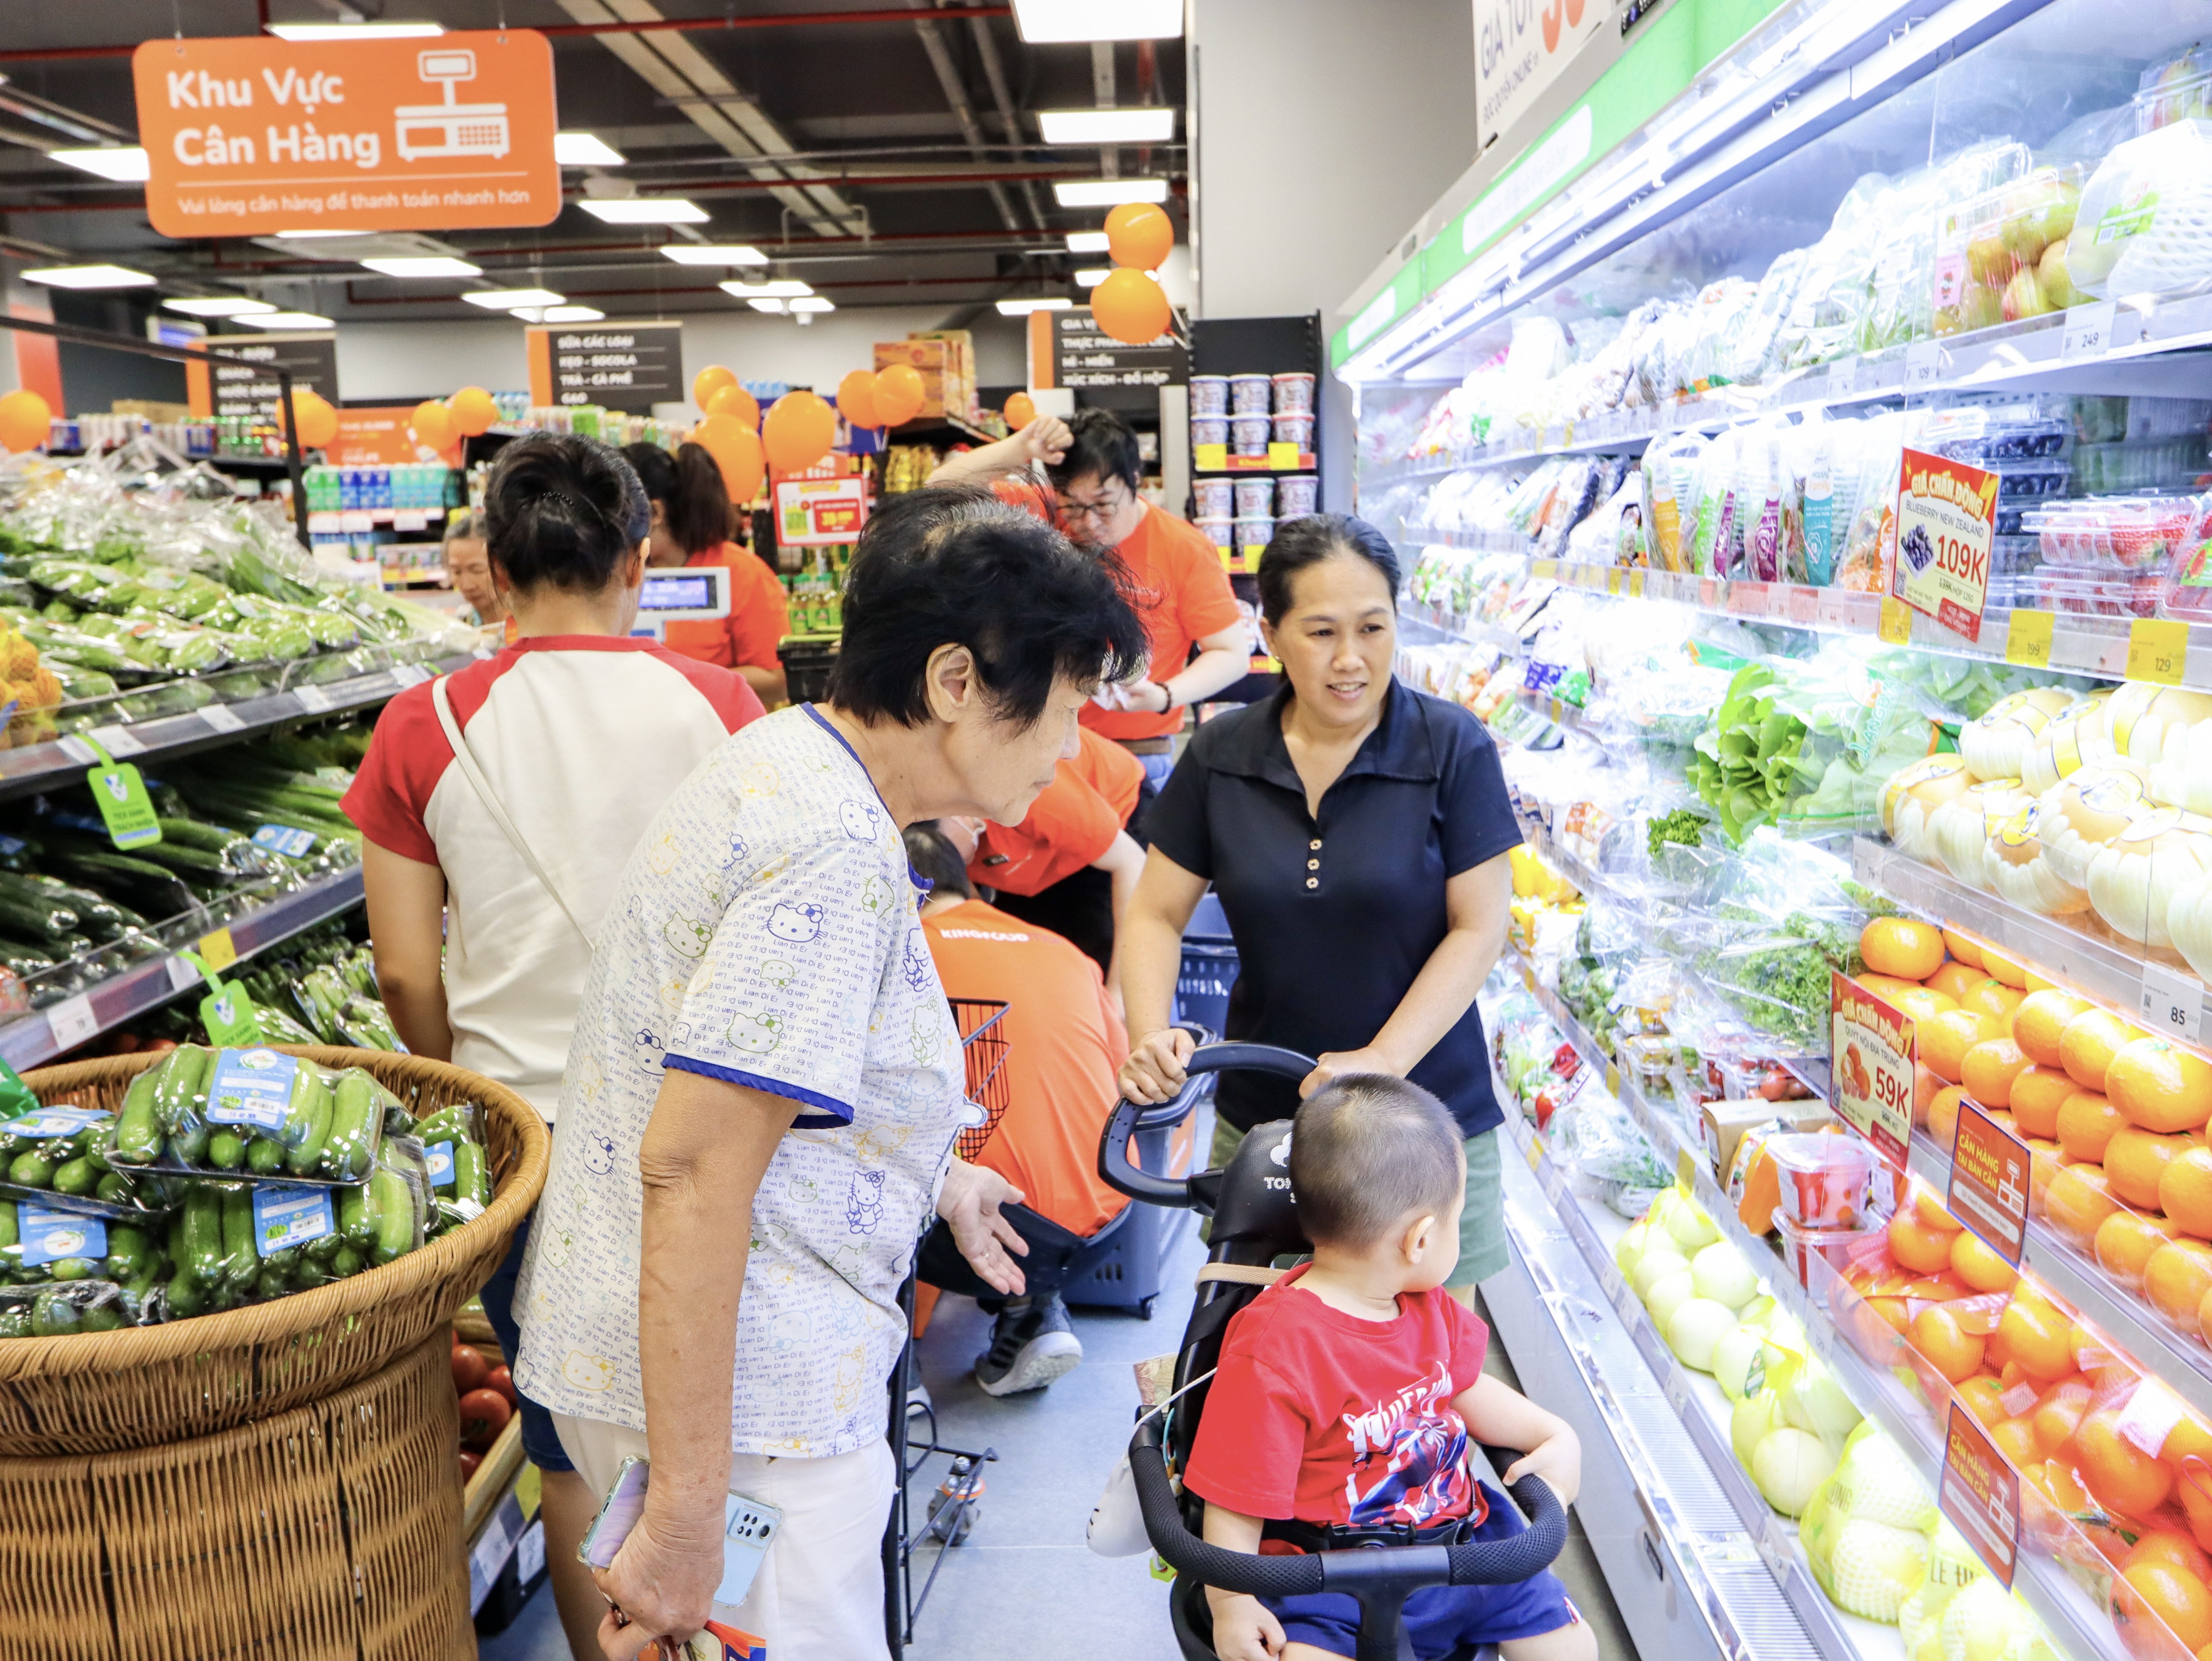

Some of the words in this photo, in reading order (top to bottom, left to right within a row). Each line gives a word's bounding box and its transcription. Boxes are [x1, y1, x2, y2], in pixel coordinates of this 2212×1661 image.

[166, 71, 252, 108] Khu
[262, 67, 344, 114] Vực
[174, 125, 255, 166] Cân
[267, 123, 381, 168] Hàng
[178, 197, 205, 215] Vui
[208, 196, 246, 216] lòng
[281, 193, 324, 214] hàng
[327, 191, 347, 210] để
[350, 192, 399, 210] thanh
[402, 189, 440, 208] toán
[443, 189, 495, 206] nhanh
[498, 189, 530, 205] hơn
[558, 334, 581, 349] SỮA
[582, 334, 606, 348] CÁC
[1061, 319, 1084, 331] GIA
[1061, 336, 1094, 350] THỰC
[2082, 332, 2099, 348] 249
[560, 372, 584, 386] TRÀ
[592, 371, 608, 386] CÀ
[591, 354, 638, 367] SOCOLA
[1911, 469, 1928, 497] GIÁ
[1929, 470, 1955, 503] CHẤN
[1955, 481, 1983, 521] ĐỘNG
[1906, 500, 1939, 518] BLUEBERRY
[1940, 513, 1954, 527] NEW
[1956, 518, 1984, 537] ZEALAND
[1936, 534, 1985, 586] 109K
[2027, 643, 2040, 656] 199
[2156, 657, 2171, 672] 129
[1842, 997, 1856, 1023] GIÁ
[1856, 1002, 1879, 1034] CHẤN
[1879, 1015, 1905, 1058] ĐỘNG
[2171, 1006, 2185, 1025] 85
[1845, 1025, 1859, 1041] QUÝT
[1860, 1033, 1868, 1050] NỘI
[1870, 1042, 1879, 1058] ĐỊA
[1881, 1049, 1900, 1070] TRUNG
[1875, 1066, 1909, 1119] 59K
[1958, 1151, 1968, 1169] TẠI
[1968, 1160, 1982, 1179] BÀN
[1982, 1171, 1997, 1190] CÂN
[1959, 1134, 1975, 1156] CÂN
[1976, 1147, 1999, 1174] HÀNG
[1951, 1434, 1967, 1460] CÂN
[1967, 1455, 1990, 1489] HÀNG
[1960, 1465, 1974, 1488] BÀN
[1974, 1480, 1989, 1504] CÂN
